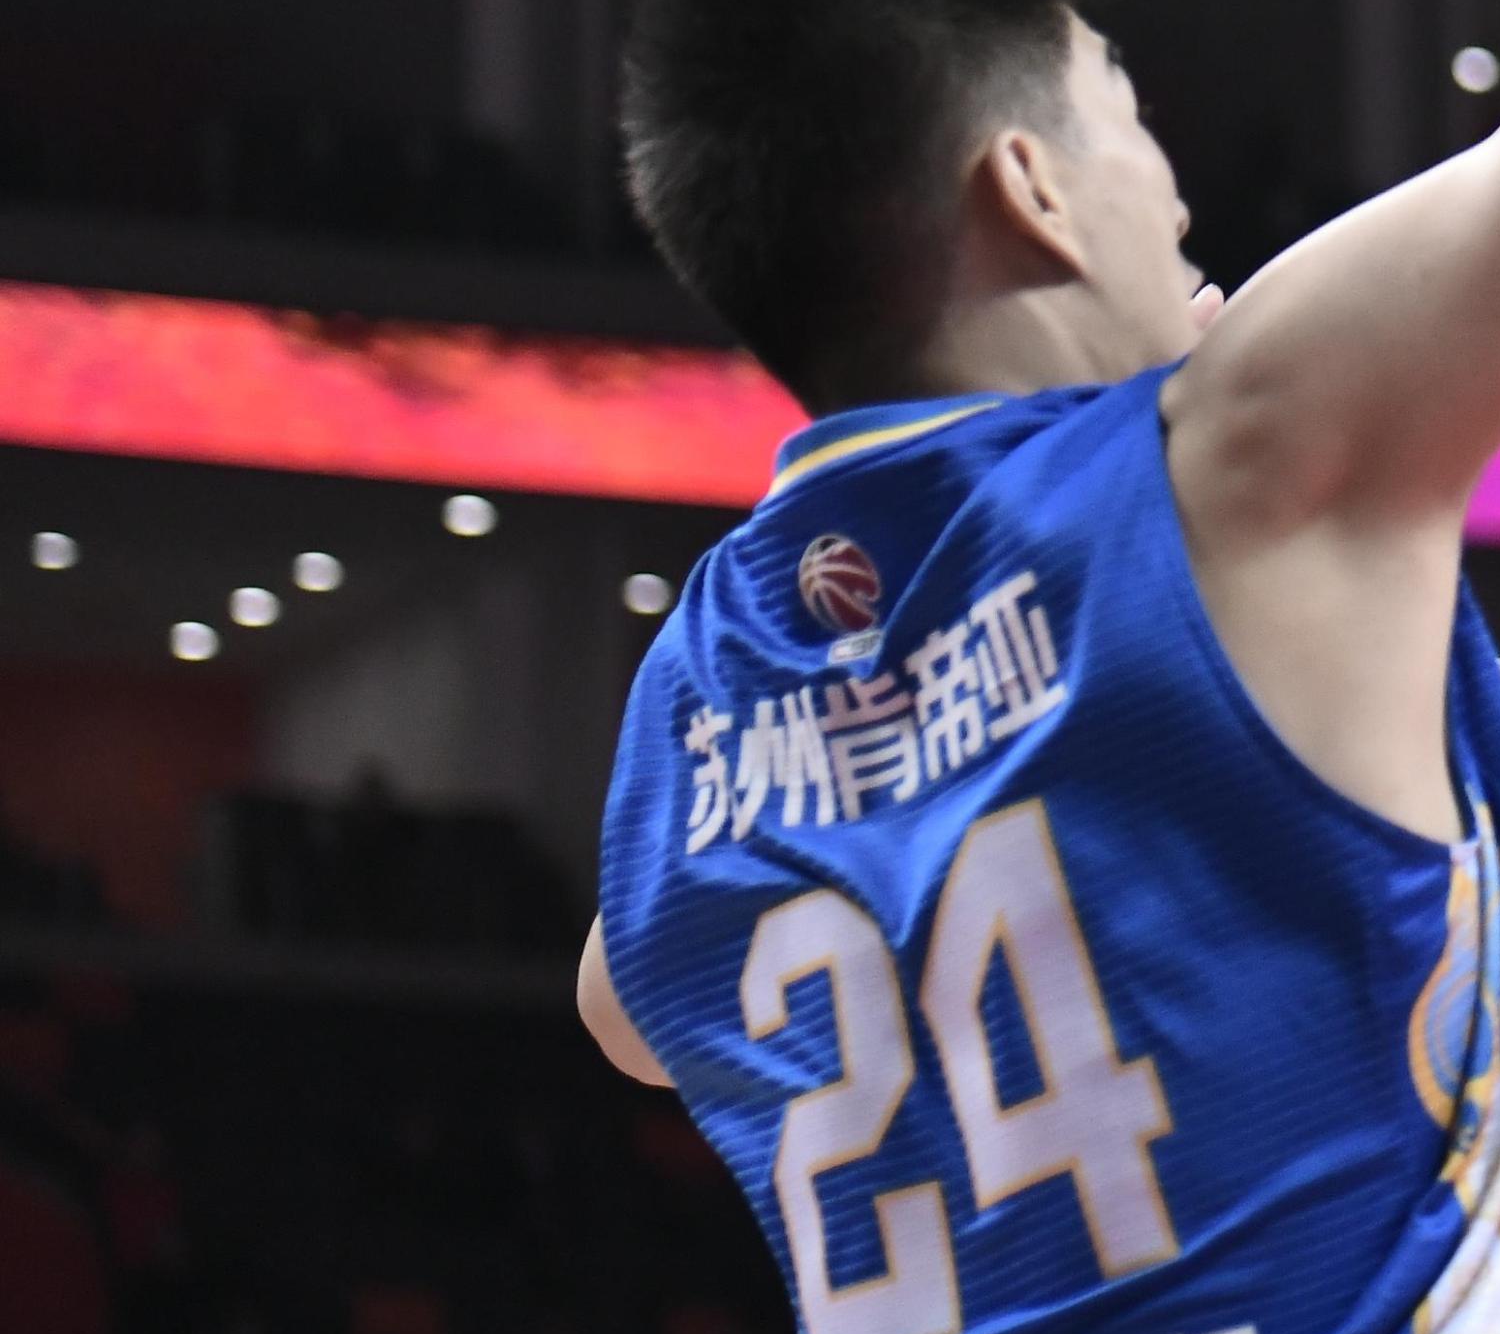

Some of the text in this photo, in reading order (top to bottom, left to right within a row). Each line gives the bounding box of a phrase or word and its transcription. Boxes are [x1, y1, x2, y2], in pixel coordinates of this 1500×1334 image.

[684, 570, 1069, 854] 苏州肯帝亚
